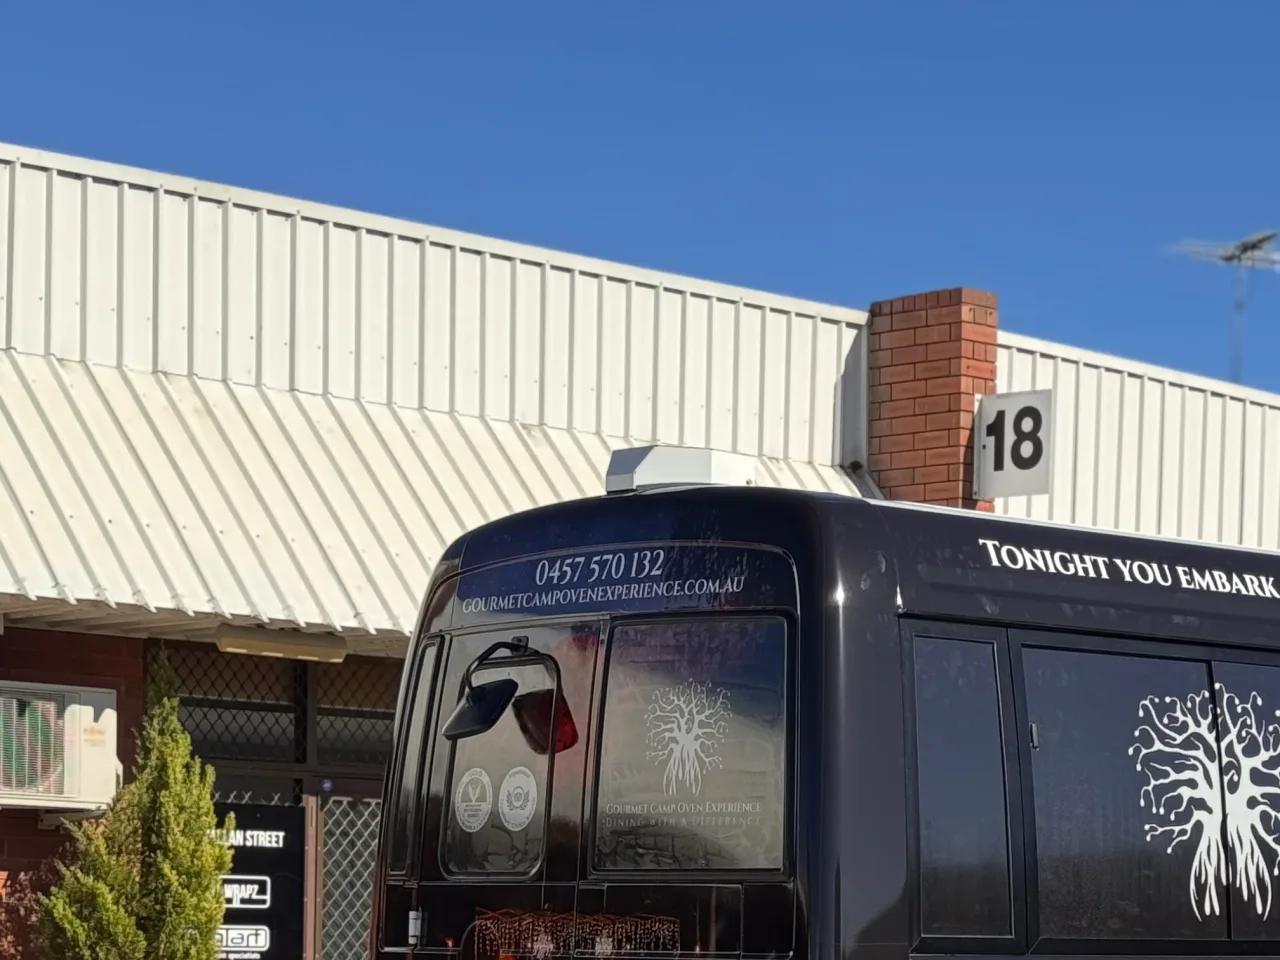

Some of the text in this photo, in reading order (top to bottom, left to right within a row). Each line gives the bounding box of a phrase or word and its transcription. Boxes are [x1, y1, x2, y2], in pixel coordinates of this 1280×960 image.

[986, 405, 1043, 471] 18
[535, 549, 665, 586] 0457 570 132
[978, 538, 1108, 579] TONIGHT
[1112, 556, 1172, 587] YOU
[1175, 565, 1280, 599] EMBARK
[462, 576, 745, 614] GOURMETCAMPOVENEXPERIENCE.COM.AU
[606, 801, 762, 814] GOURMET CAMP OVEN EXPERIENCE
[245, 830, 286, 848] STREET
[224, 884, 259, 903] WRAPZ
